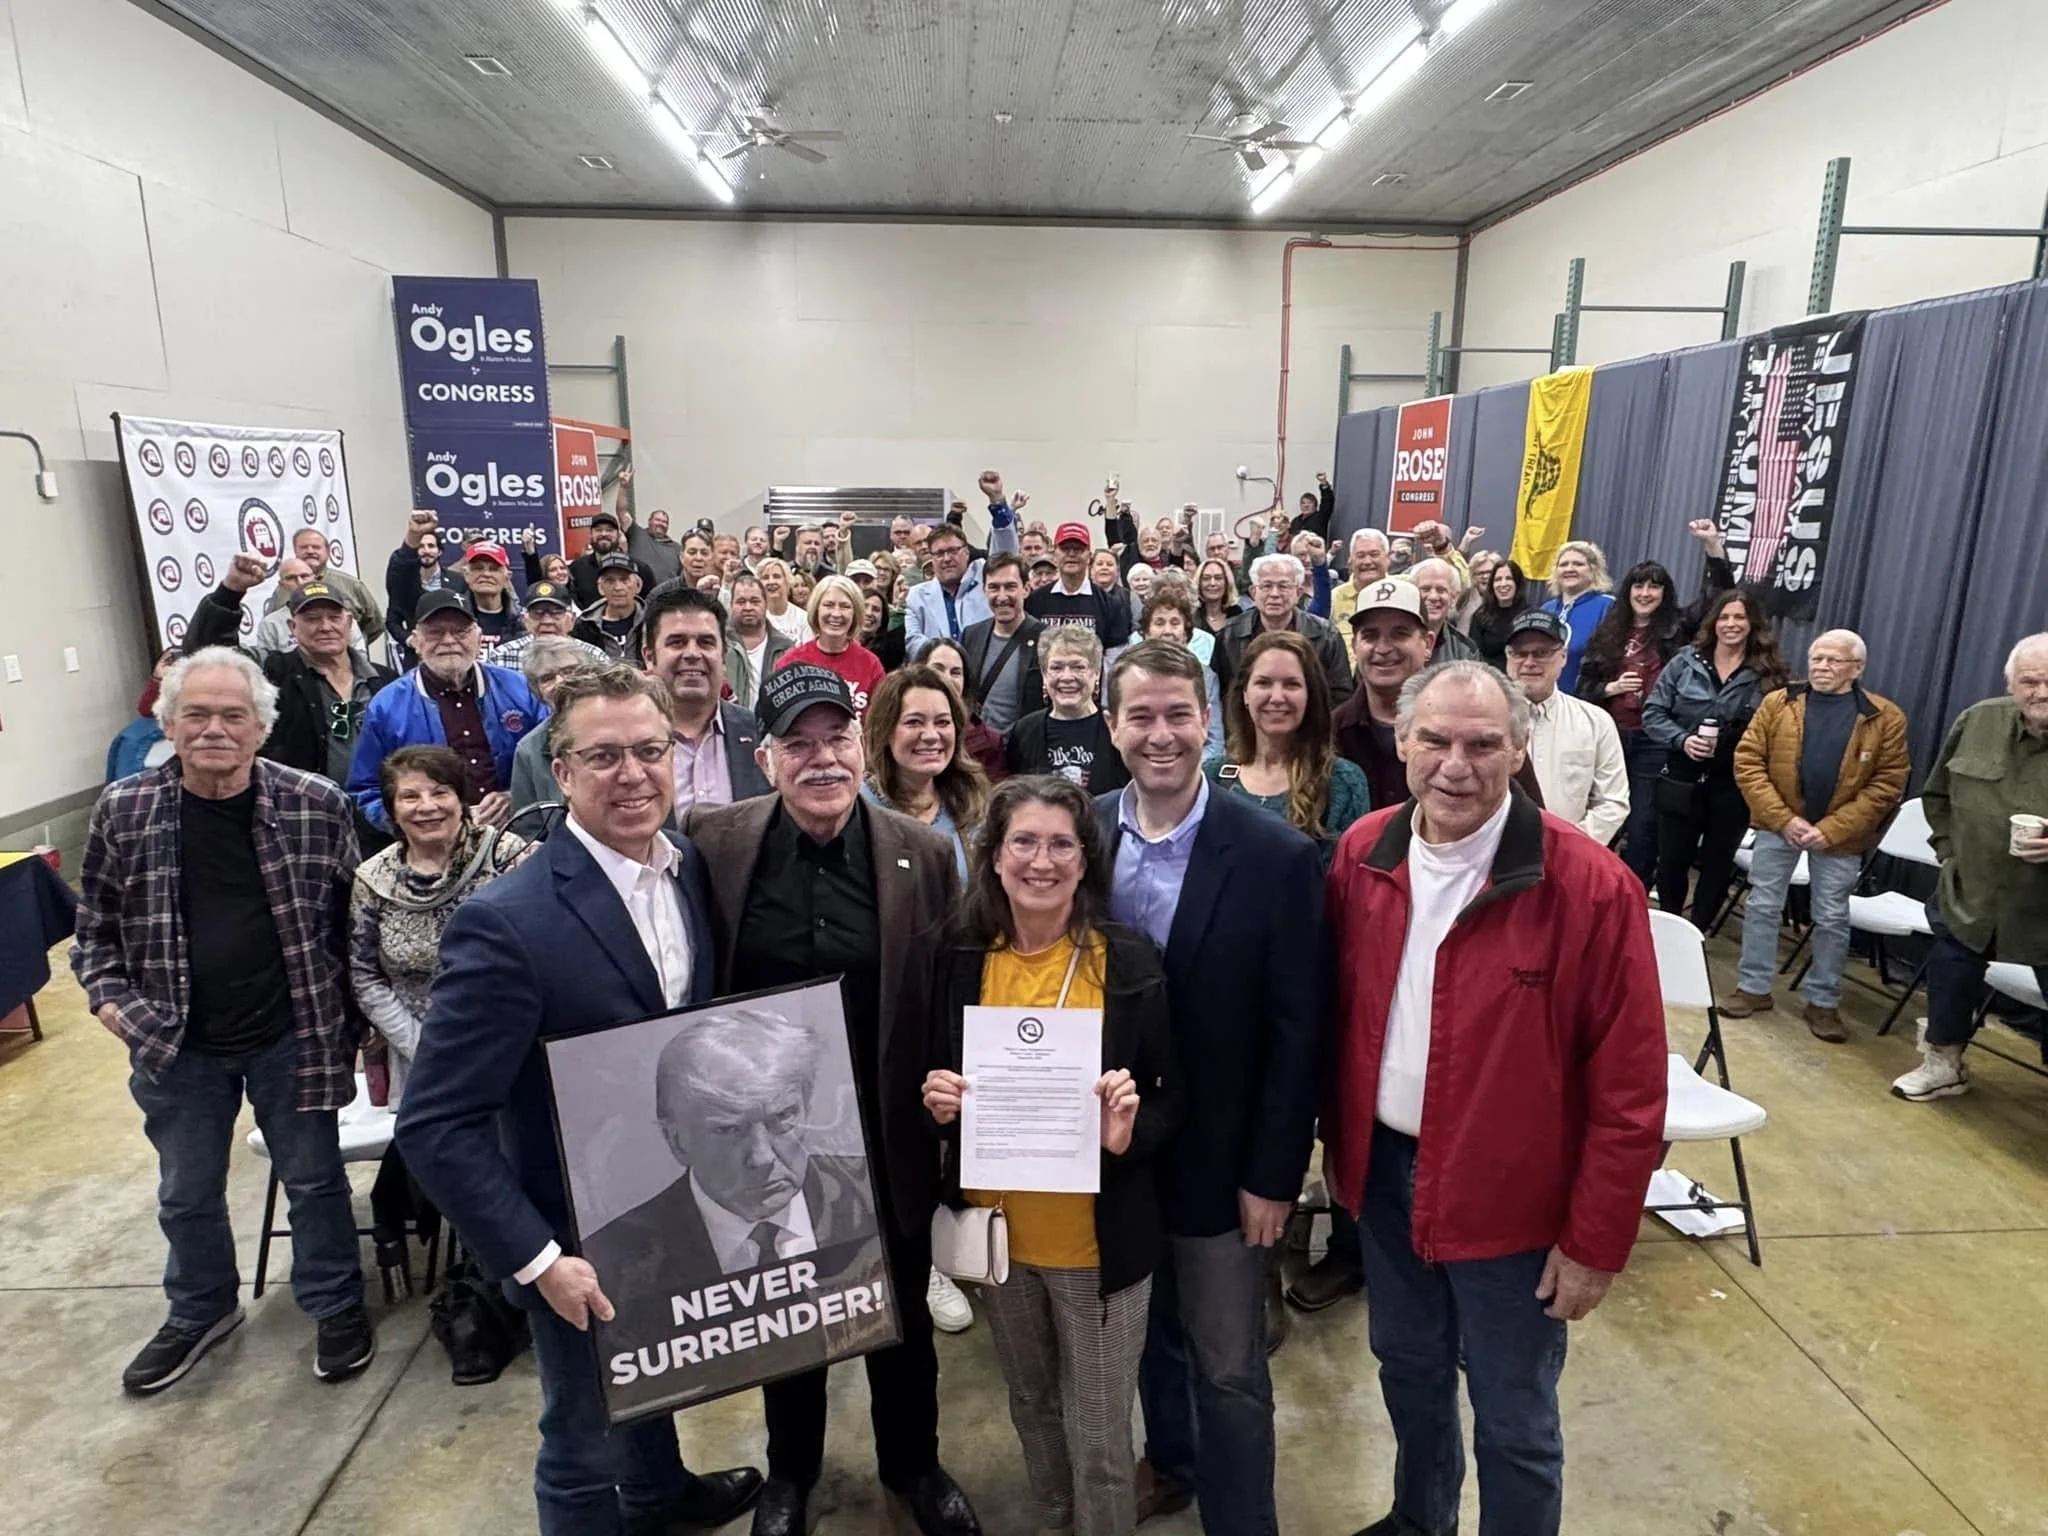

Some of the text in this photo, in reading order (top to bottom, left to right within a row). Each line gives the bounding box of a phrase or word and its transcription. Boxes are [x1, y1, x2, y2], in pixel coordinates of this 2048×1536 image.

[411, 303, 443, 317] Andy
[410, 315, 534, 362] Ogles
[1812, 334, 1831, 371] IS
[418, 383, 535, 403] CONGRESS
[1739, 381, 1755, 421] MY
[1802, 382, 1817, 440] MY
[1412, 426, 1435, 441] JOHN
[427, 451, 458, 465] Andy
[571, 454, 588, 467] JOHN
[1396, 447, 1446, 482] ROSE
[1783, 331, 1853, 592] JESUS
[425, 462, 545, 506] Ogles
[560, 474, 601, 507] ROSE
[1401, 491, 1436, 502] CONGRESS
[1718, 430, 1747, 546] PRESIDE
[434, 526, 547, 545] COGRES
[765, 669, 795, 697] MAKE
[772, 680, 841, 709] GREAT AGAIN
[671, 1260, 819, 1326] NEVER
[609, 1281, 885, 1386] SURRENDER!
